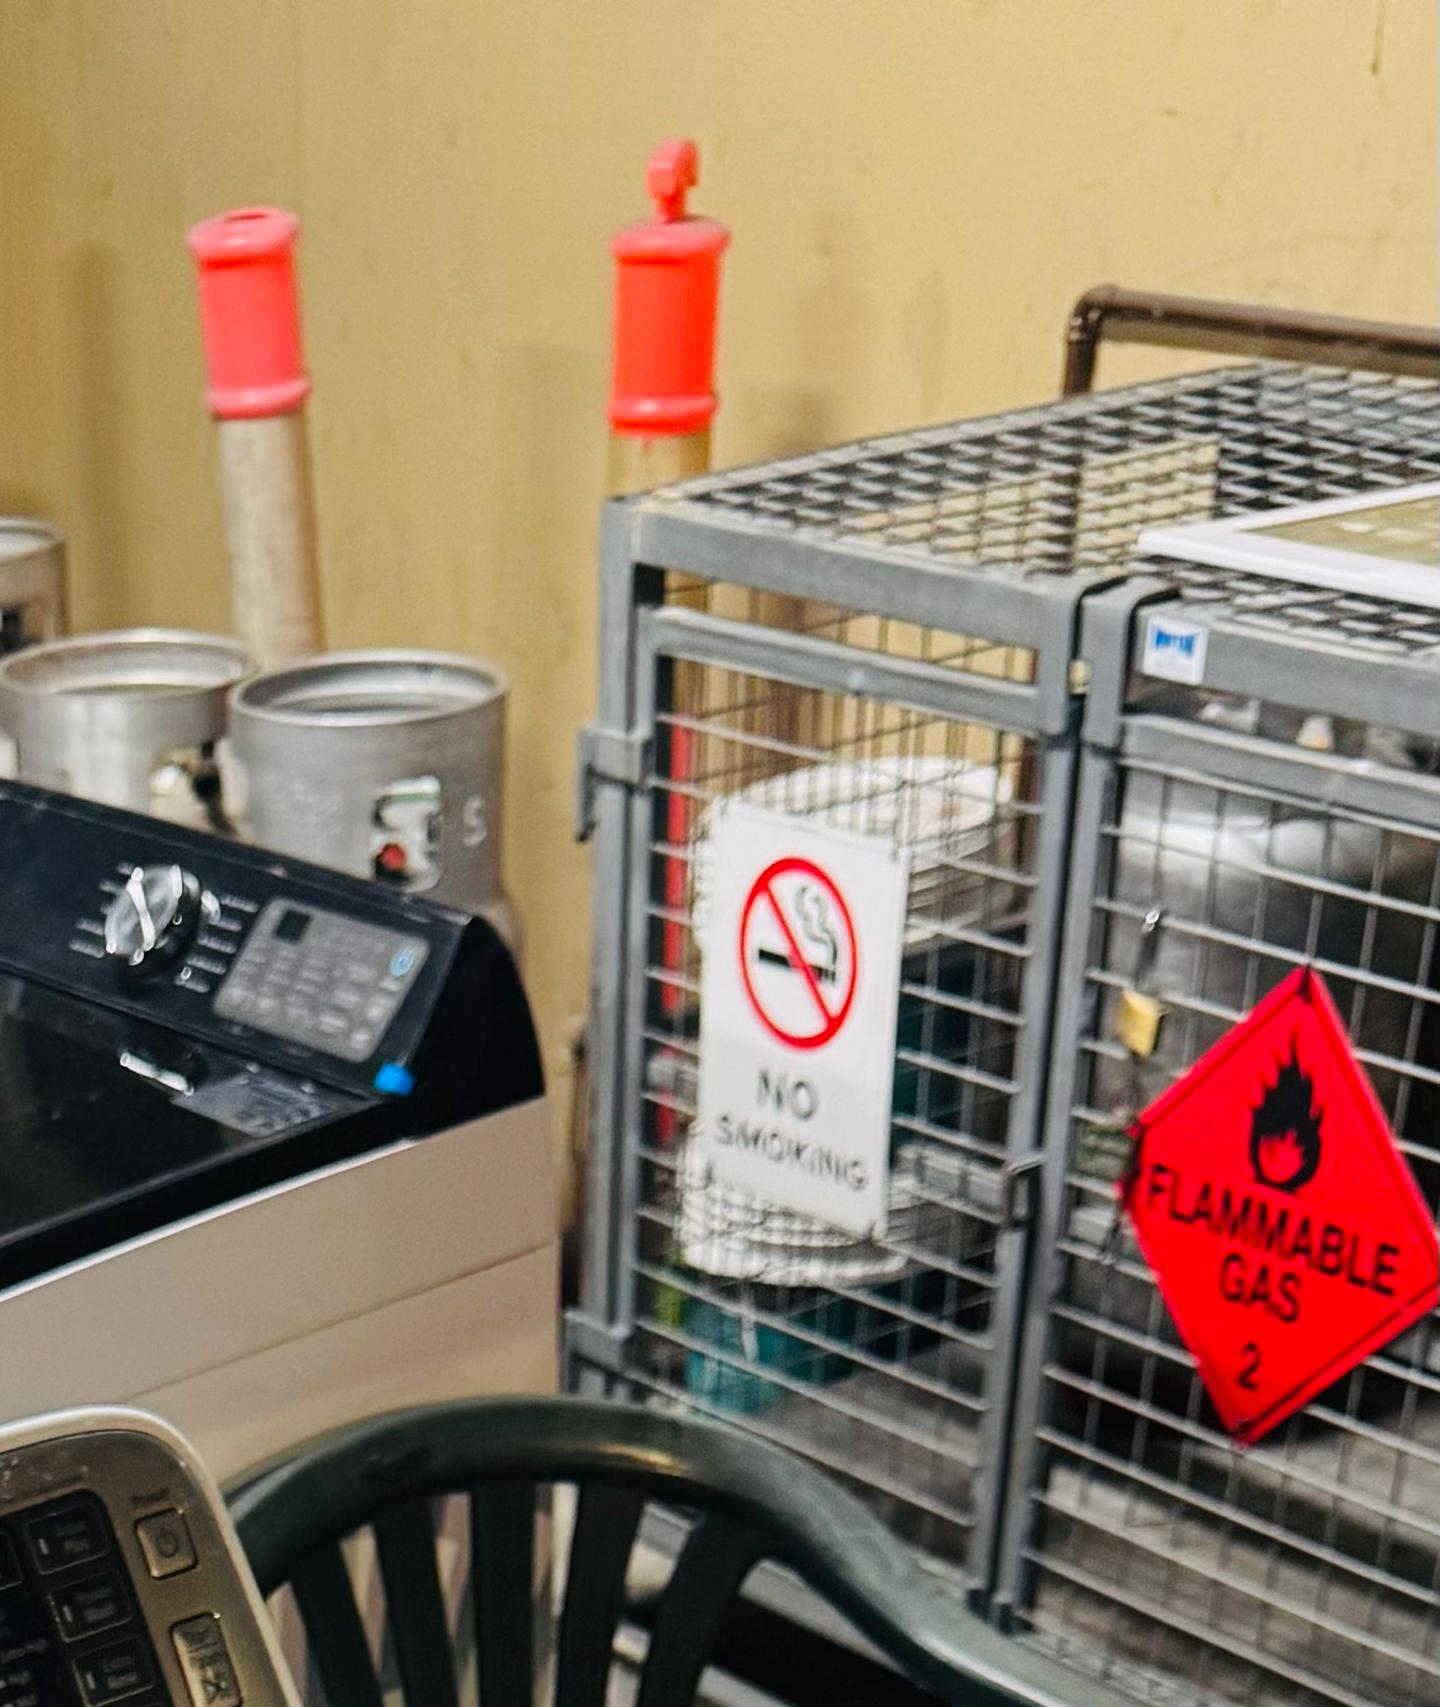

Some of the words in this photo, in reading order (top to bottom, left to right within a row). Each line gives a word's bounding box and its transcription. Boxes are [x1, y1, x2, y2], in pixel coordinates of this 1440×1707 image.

[757, 1067, 821, 1121] NO
[715, 1113, 868, 1191] SMOKING
[1148, 1163, 1400, 1297] FLAMMABLE
[1220, 1252, 1301, 1324] GAS
[1237, 1341, 1260, 1391] 2
